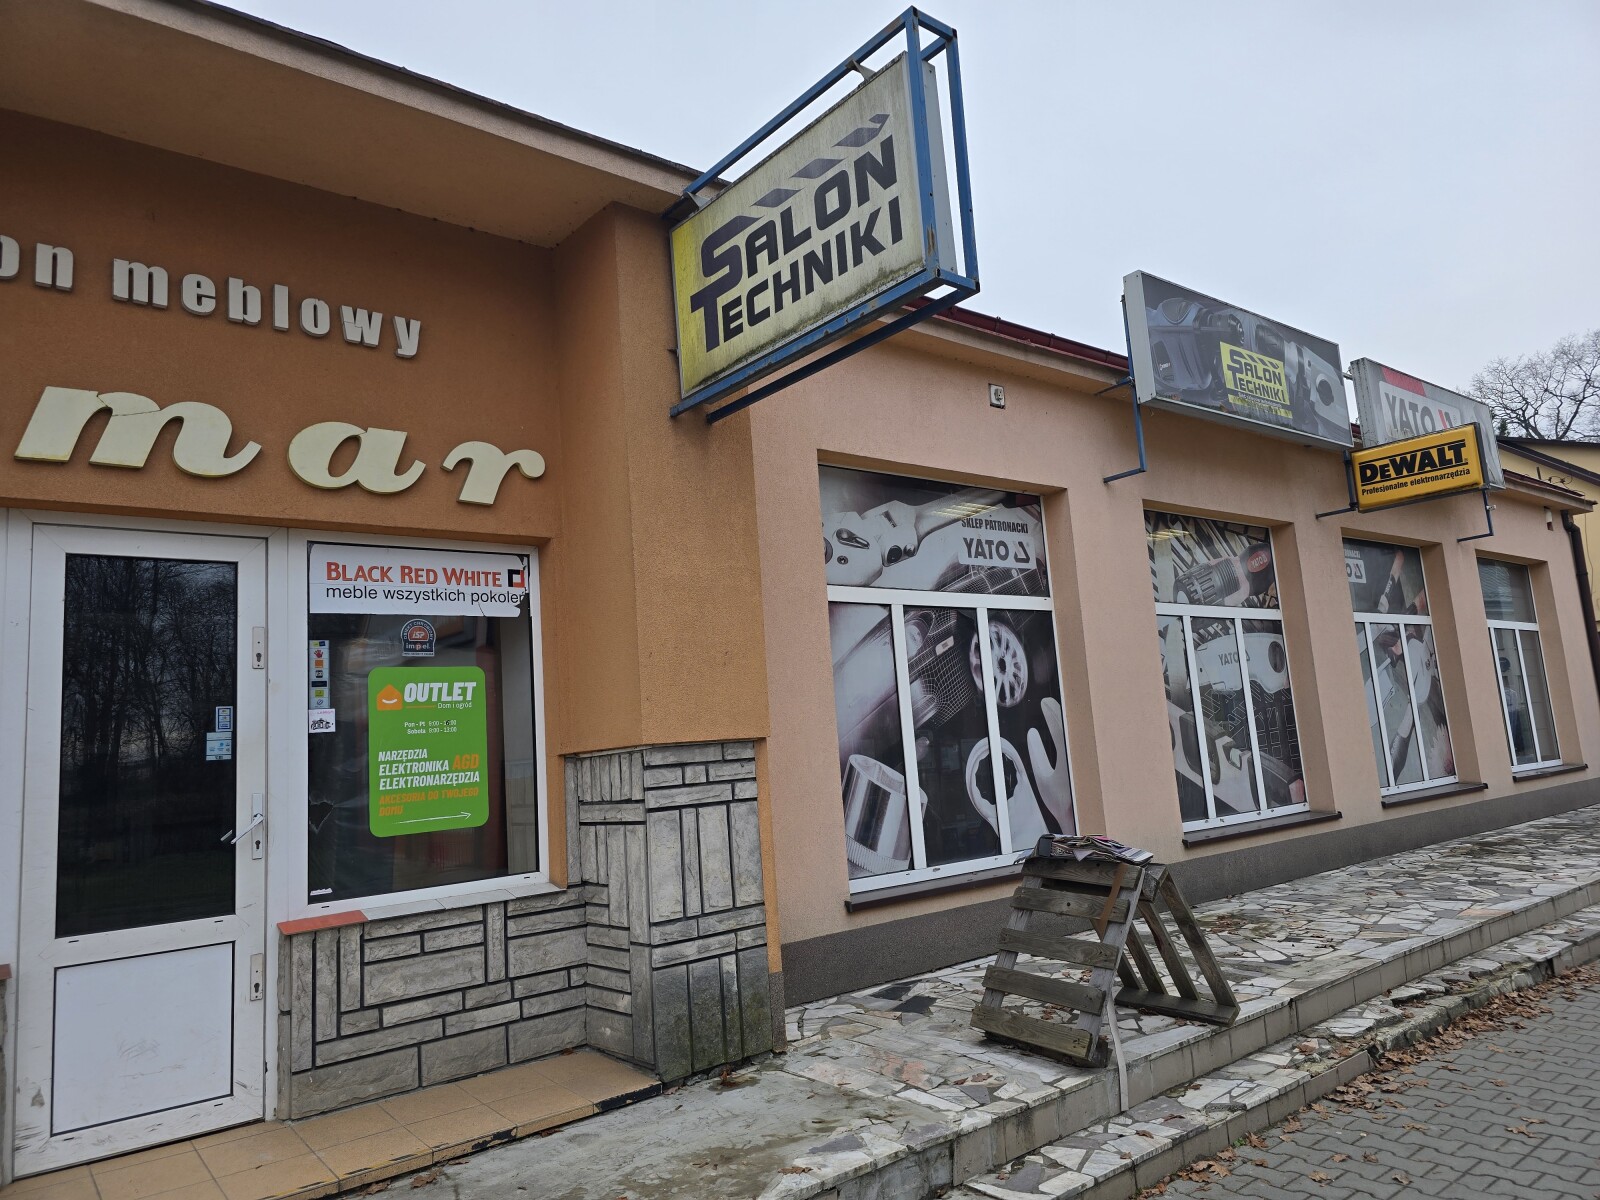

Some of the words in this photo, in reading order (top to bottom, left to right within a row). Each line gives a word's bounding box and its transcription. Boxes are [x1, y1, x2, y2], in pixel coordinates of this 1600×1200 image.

[701, 134, 898, 279] SALON
[690, 195, 903, 353] TECHNIKI
[112, 258, 421, 358] meblowy
[1229, 348, 1283, 387] SALON
[1227, 364, 1286, 403] TECHNIKI
[1385, 392, 1436, 435] YATO
[14, 385, 546, 505] mar
[1361, 480, 1409, 496] Profesjonalne
[1410, 467, 1471, 486] elektronarzędzia
[961, 517, 984, 530] SKLEP
[984, 519, 1029, 534] PATRONACKI
[963, 537, 1010, 561] YATO
[326, 561, 393, 583] BLACK
[400, 565, 438, 585] RED
[442, 567, 502, 587] WHITE
[326, 585, 378, 599] meble
[383, 588, 465, 603] wszystkich
[1218, 651, 1239, 666] YATO
[403, 681, 477, 703] OUTLET
[378, 748, 428, 762] NARZĘDZIA
[379, 760, 450, 776] ELEKTRONIKA
[452, 753, 480, 770] AGD
[379, 771, 480, 791] ELEKTRONARZĘDZIA
[379, 791, 426, 805] AKCESORIA
[427, 790, 439, 801] DO
[441, 787, 479, 799] TWOJEGO
[378, 805, 404, 817] DOMU
